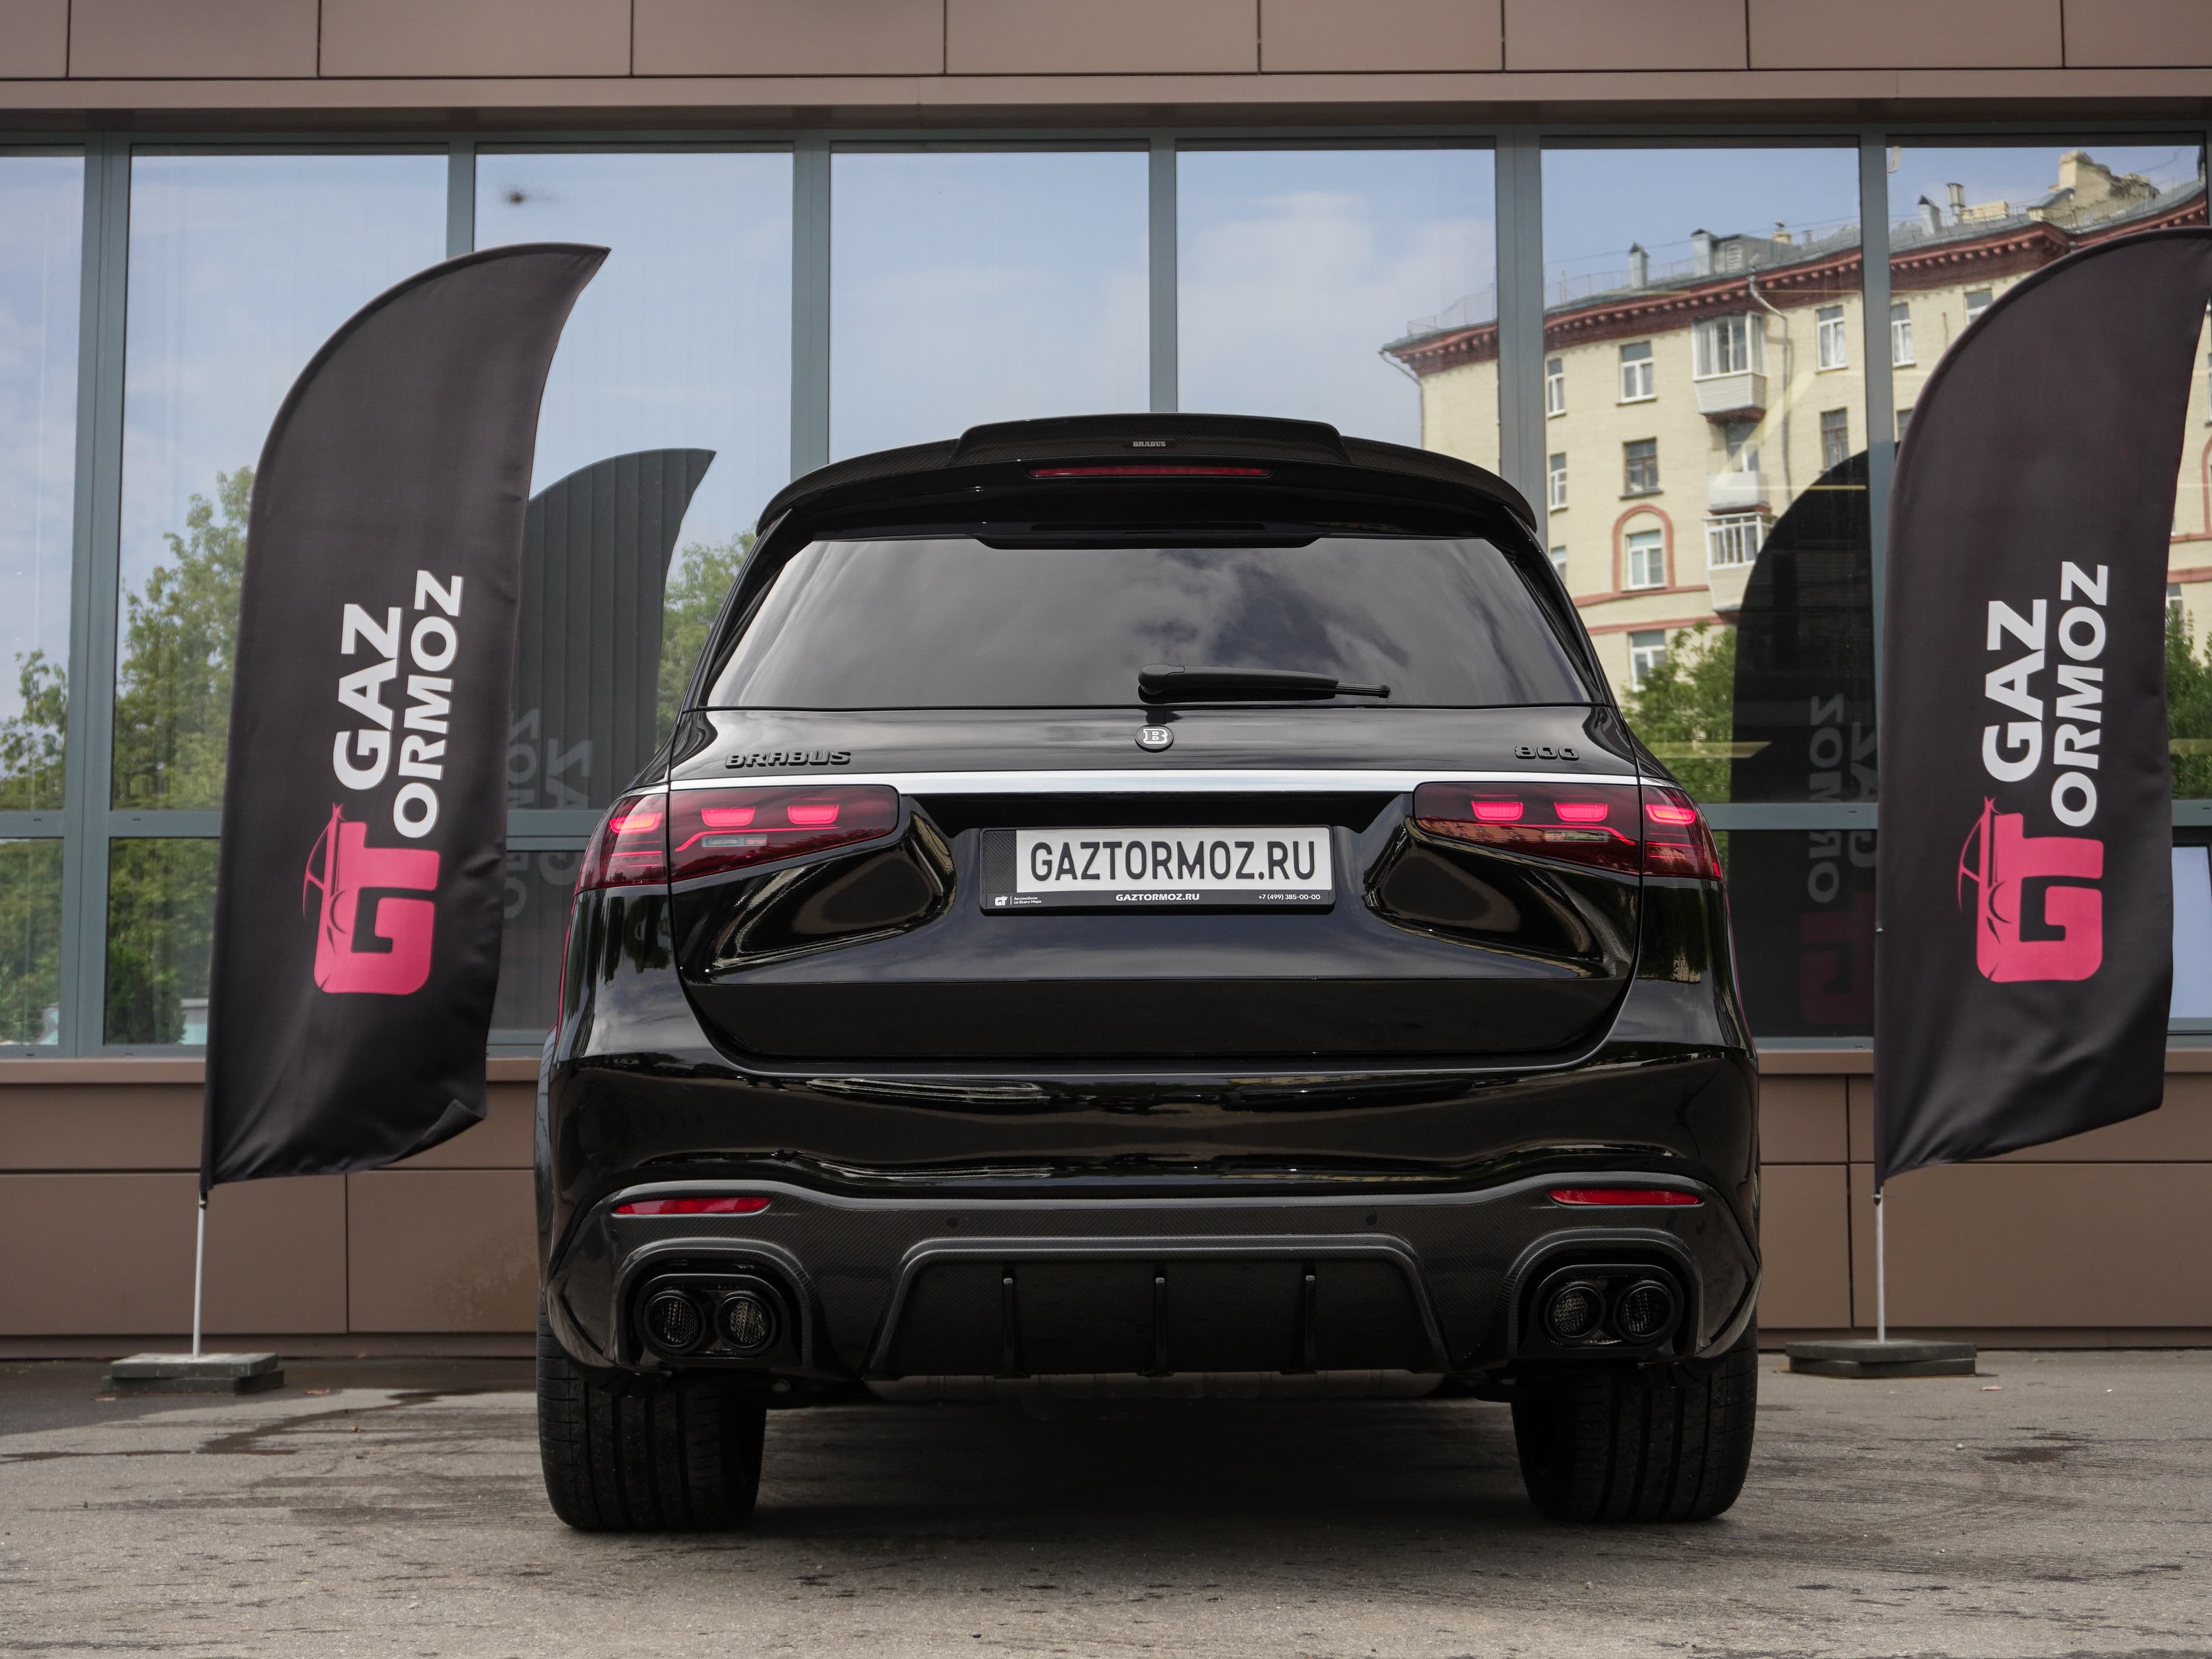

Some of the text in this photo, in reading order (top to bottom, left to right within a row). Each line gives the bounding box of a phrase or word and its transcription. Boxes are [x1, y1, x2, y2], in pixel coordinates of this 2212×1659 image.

[333, 603, 401, 790] GAZ
[393, 569, 464, 838] ORMOZ
[1143, 728, 1168, 745] B
[1982, 599, 2047, 782] GAZ
[2051, 561, 2108, 827] ORMOZ
[725, 749, 851, 769] BRABUS
[1514, 746, 1579, 761] 800
[1030, 841, 1315, 881] GAZTORMOZ.RU
